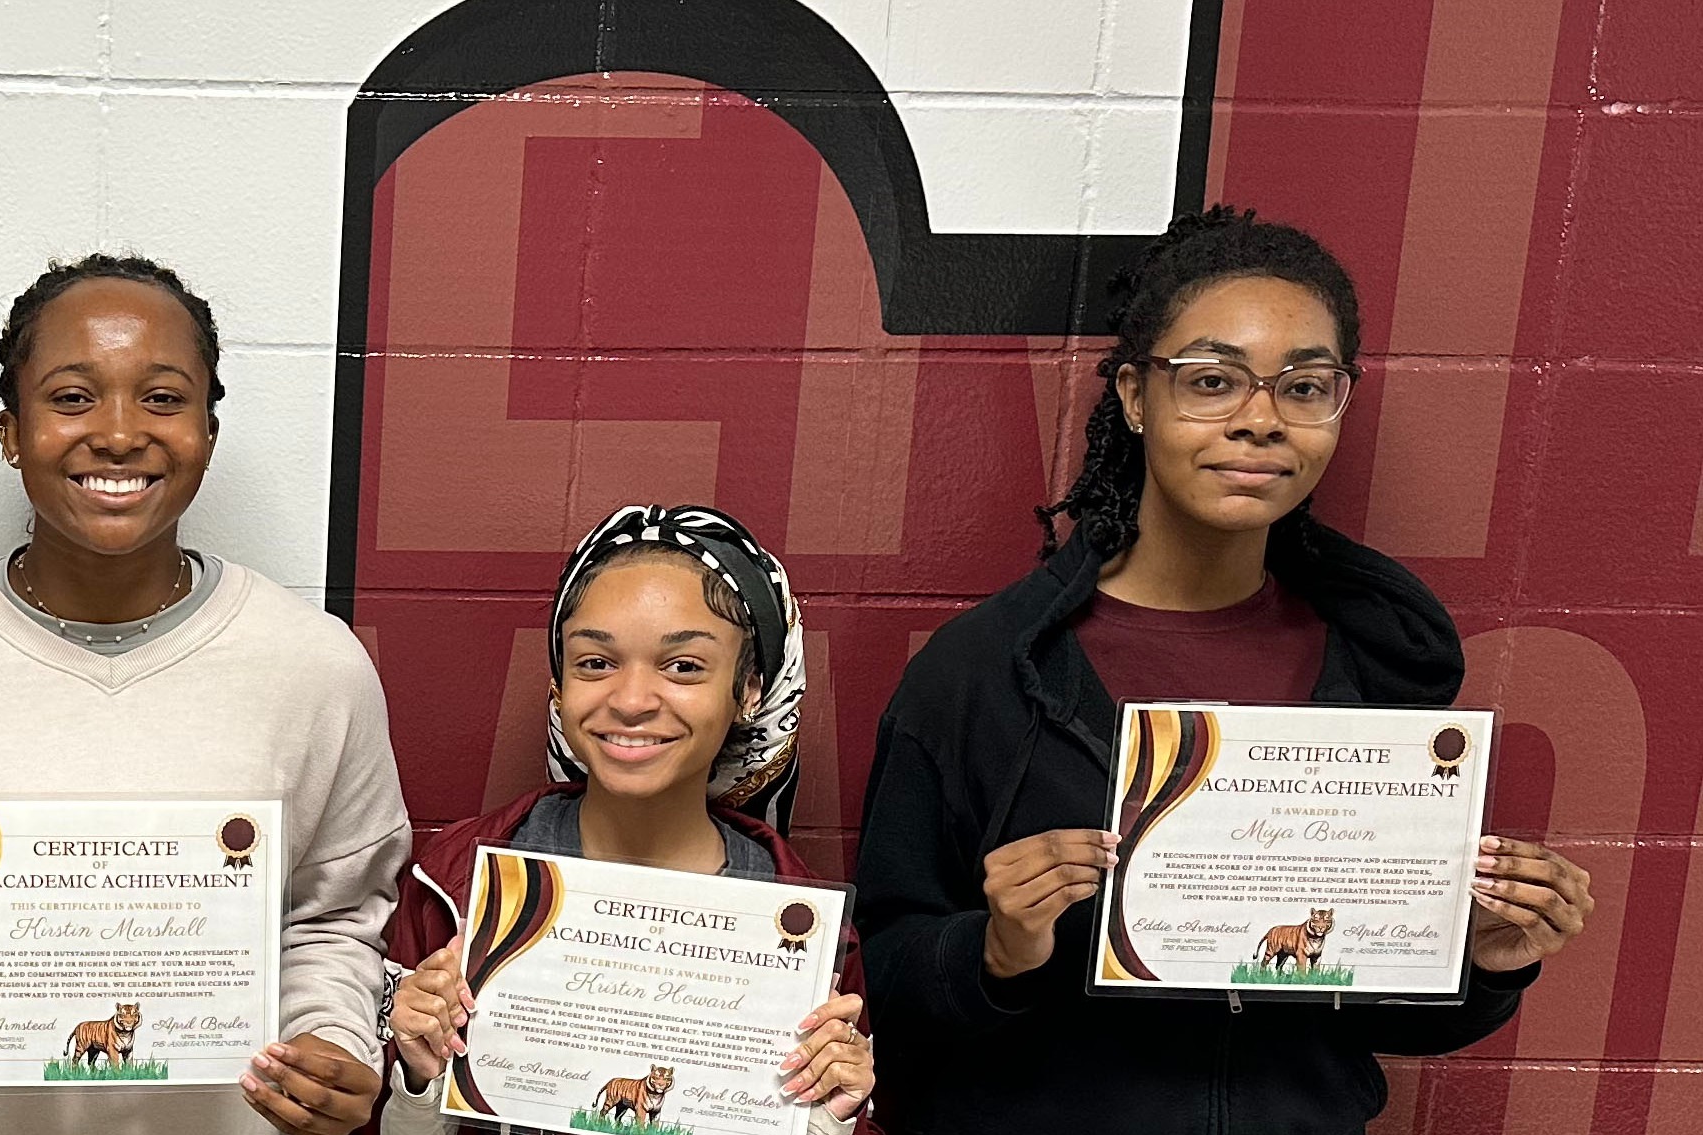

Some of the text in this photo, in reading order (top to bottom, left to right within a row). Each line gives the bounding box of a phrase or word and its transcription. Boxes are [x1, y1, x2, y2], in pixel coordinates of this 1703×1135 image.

[1248, 745, 1390, 763] CERTIFICATE
[1303, 766, 1320, 775] OF
[1200, 777, 1458, 797] ACADEMIC ACHIEVEMENT
[1270, 806, 1357, 817] IS AWARDED TO
[1230, 818, 1376, 849] Miya Brown
[32, 840, 178, 856] CERTIFICATE
[91, 860, 108, 870] OF
[101, 873, 252, 888] ACHIEVEMENT
[9, 901, 201, 911] THIS CERTIFICATE IS AWARDED TO
[593, 899, 736, 931] CERTIFICATE
[99, 915, 207, 942] Marshall
[648, 925, 665, 935] OF
[1132, 917, 1251, 933] Eddie Armstead
[1342, 923, 1388, 941] April
[546, 925, 805, 971] ACADEMIC ACHIEVEMENT
[562, 953, 750, 986] THIS CERTIFICATE IS AWARDED TO
[653, 981, 745, 1010] Howard
[151, 1015, 197, 1035] April
[475, 1053, 591, 1081] Eddie Armstead
[682, 1085, 729, 1106] April
